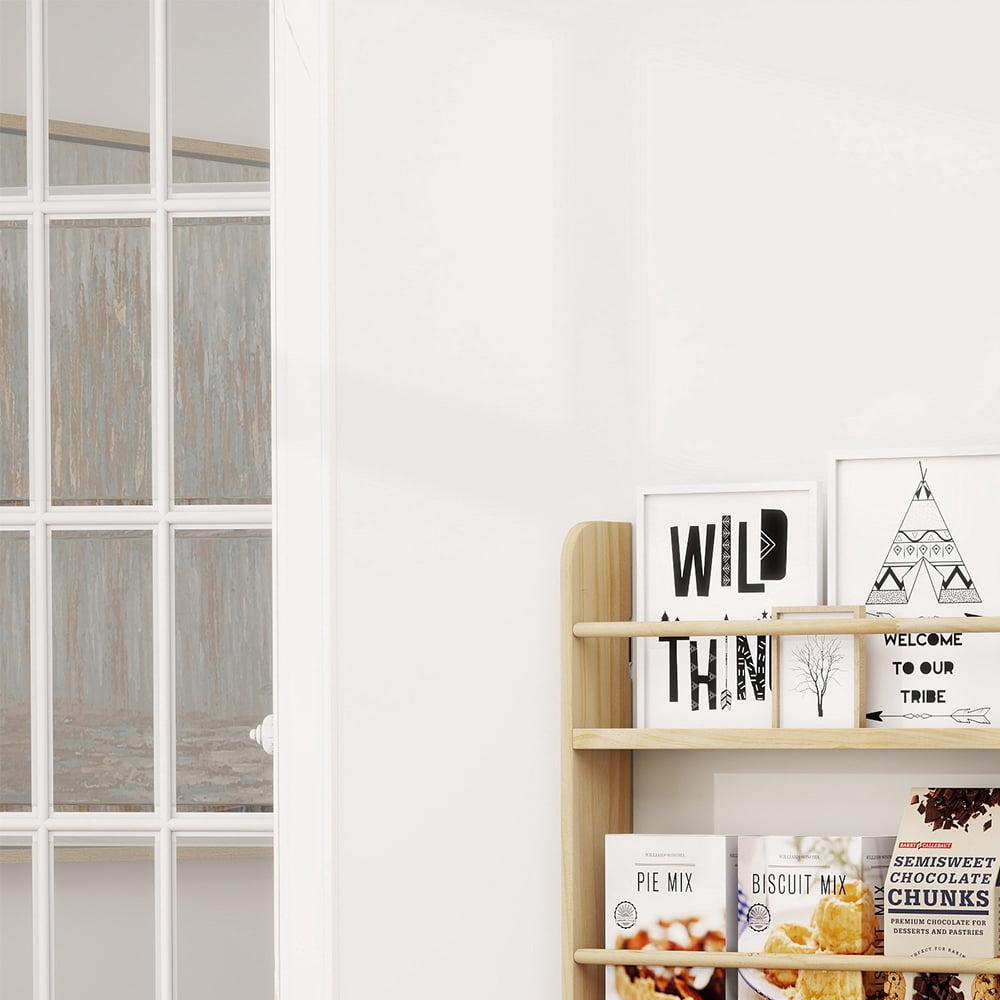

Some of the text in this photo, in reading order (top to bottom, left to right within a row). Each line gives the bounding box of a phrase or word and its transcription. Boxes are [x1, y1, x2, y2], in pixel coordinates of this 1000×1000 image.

[670, 508, 788, 597] WILD
[884, 633, 963, 647] WELCOME
[658, 635, 773, 712] THIN
[892, 661, 955, 675] TO OUR
[900, 690, 946, 704] TRIBE
[894, 855, 996, 869] SEMISWEET
[637, 871, 693, 893] PIE MIX
[752, 873, 848, 896] BISCUIT MIX
[890, 872, 992, 885] CHOCOLATE
[888, 889, 990, 908] CHUNKS
[890, 918, 987, 927] PREMIUM CHOCOLATE FOR
[893, 928, 984, 937] DESSERTS AND PASTRIES
